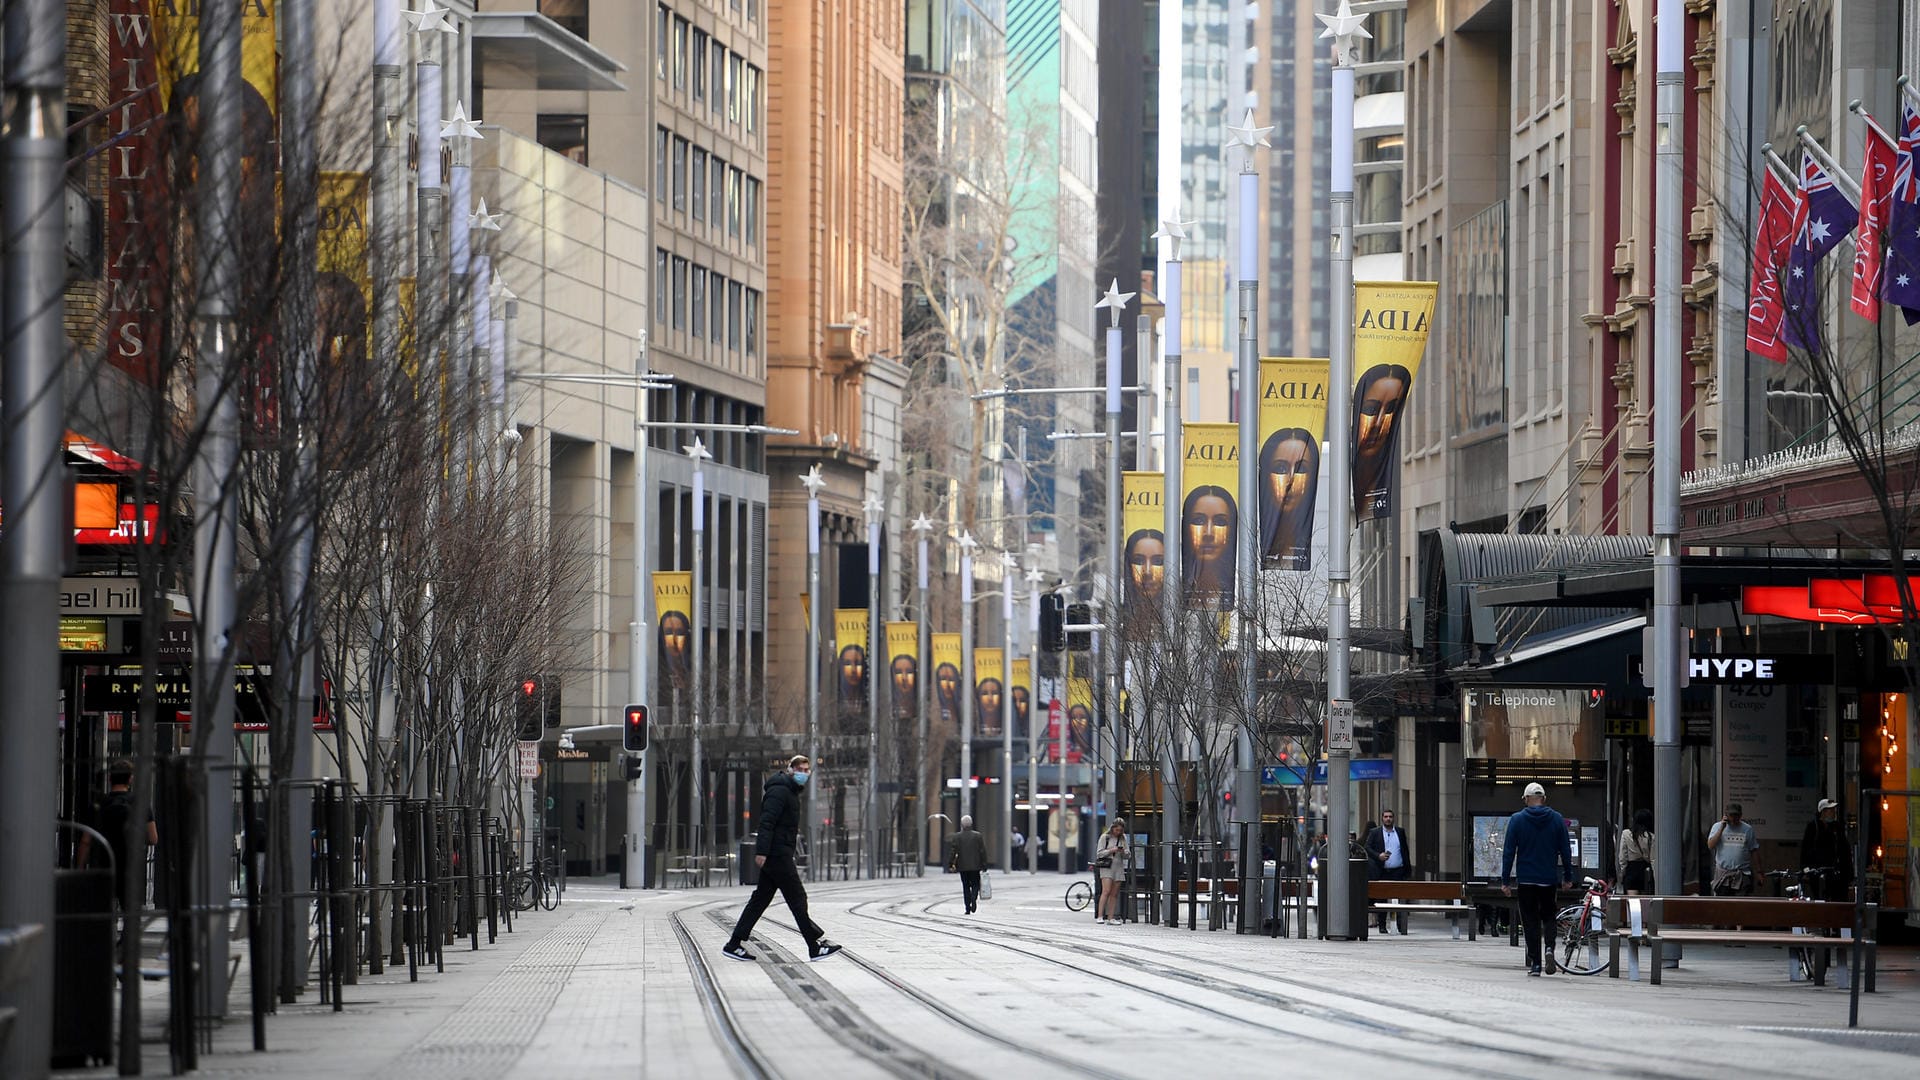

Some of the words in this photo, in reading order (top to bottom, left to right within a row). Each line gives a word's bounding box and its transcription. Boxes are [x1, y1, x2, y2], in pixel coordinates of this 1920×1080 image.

[155, 0, 269, 17] AIA
[108, 14, 154, 357] WILLIAMS
[655, 584, 690, 595] AIDA
[60, 588, 98, 608] ael
[106, 588, 137, 608] hil
[838, 621, 867, 632] AIDA
[889, 631, 917, 642] AIDA
[976, 657, 1001, 667] AIDA
[1689, 658, 1774, 678] HYPE
[156, 683, 255, 693] WILMS
[1729, 683, 1773, 697] 420
[1486, 692, 1556, 708] Telephone
[1729, 700, 1767, 710] George
[1745, 817, 1767, 825] vesta
